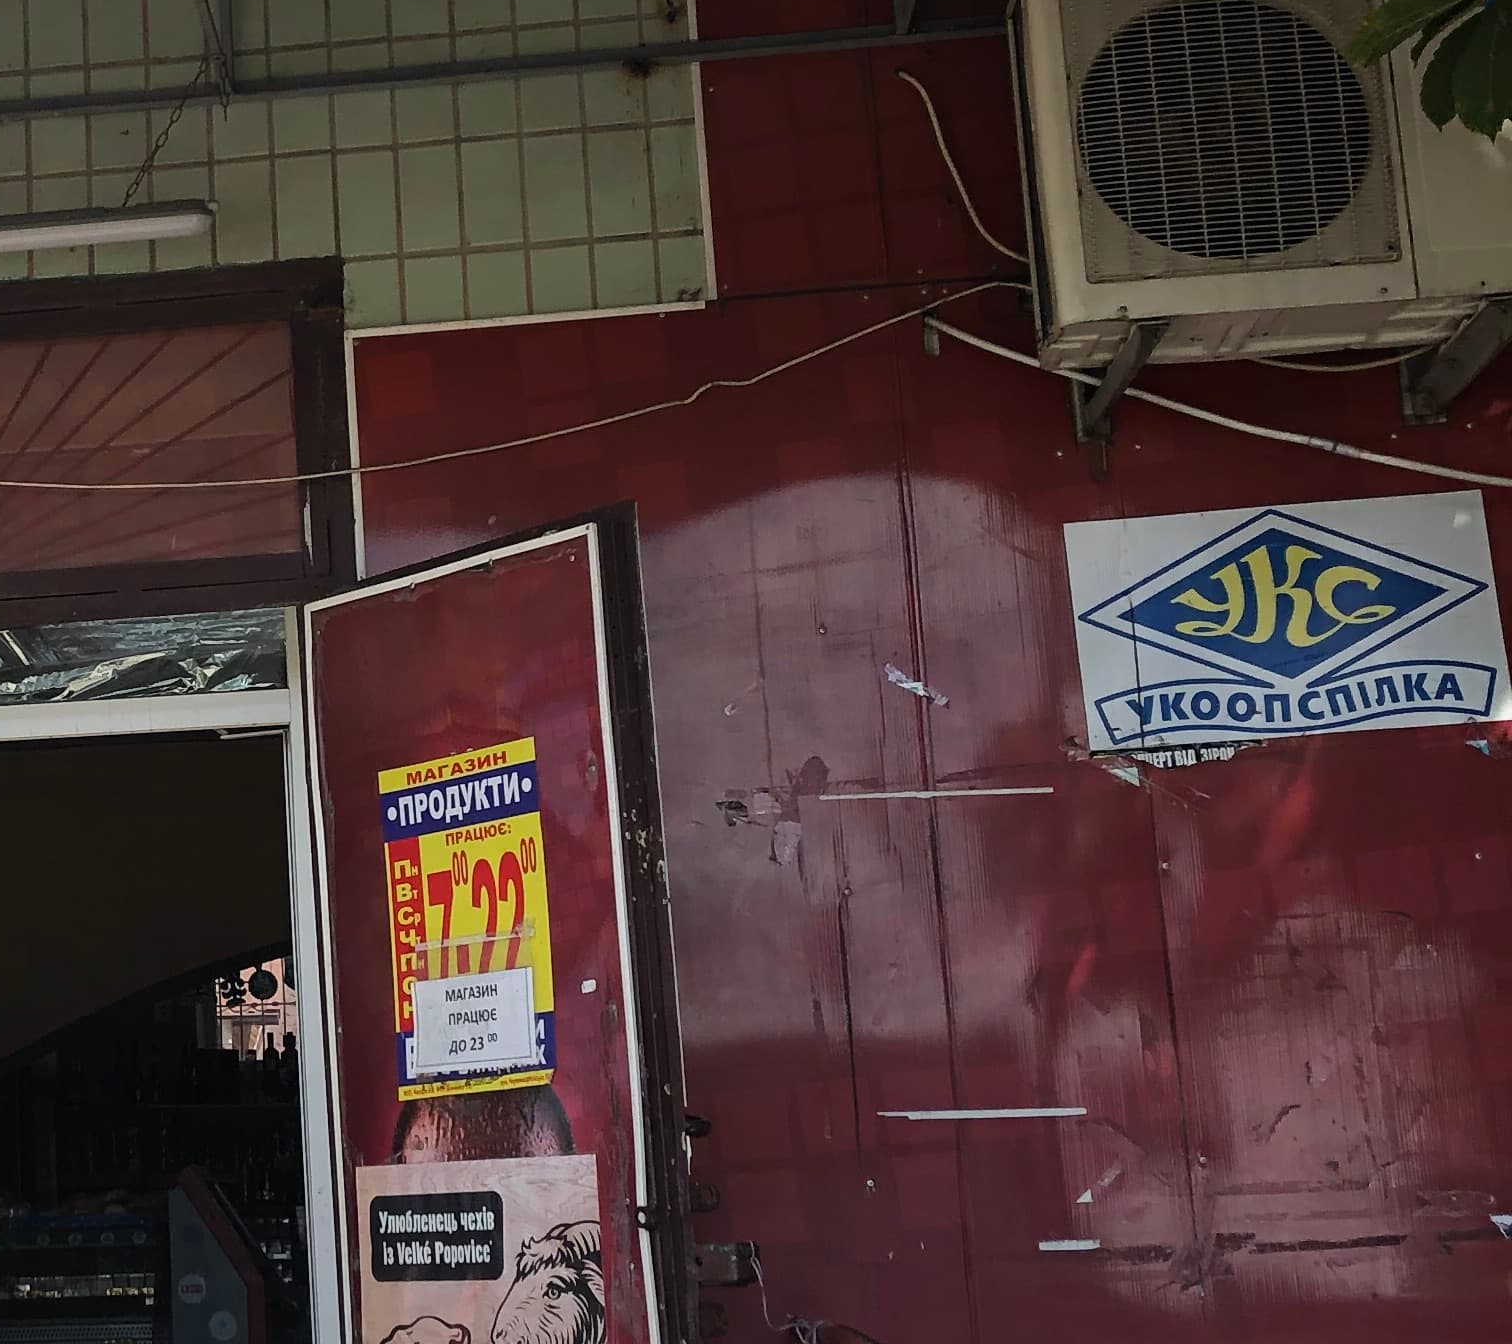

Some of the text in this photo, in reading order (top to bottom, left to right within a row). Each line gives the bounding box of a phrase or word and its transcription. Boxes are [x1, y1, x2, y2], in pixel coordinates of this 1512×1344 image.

[1170, 544, 1397, 648] УКС
[1125, 672, 1465, 727] УКООПСПІЛКА
[406, 750, 508, 785] МАГАЗИН
[444, 823, 512, 847] ПРАЦЮЄ:
[444, 983, 498, 1003] МАГАЗИН
[447, 1008, 498, 1027] ПРАЦЮЄ
[448, 1038, 467, 1056] ДО
[469, 1036, 485, 1052] 23
[378, 1206, 495, 1235] Улюбленець чехів
[382, 1239, 491, 1268] із Velké Popovice
